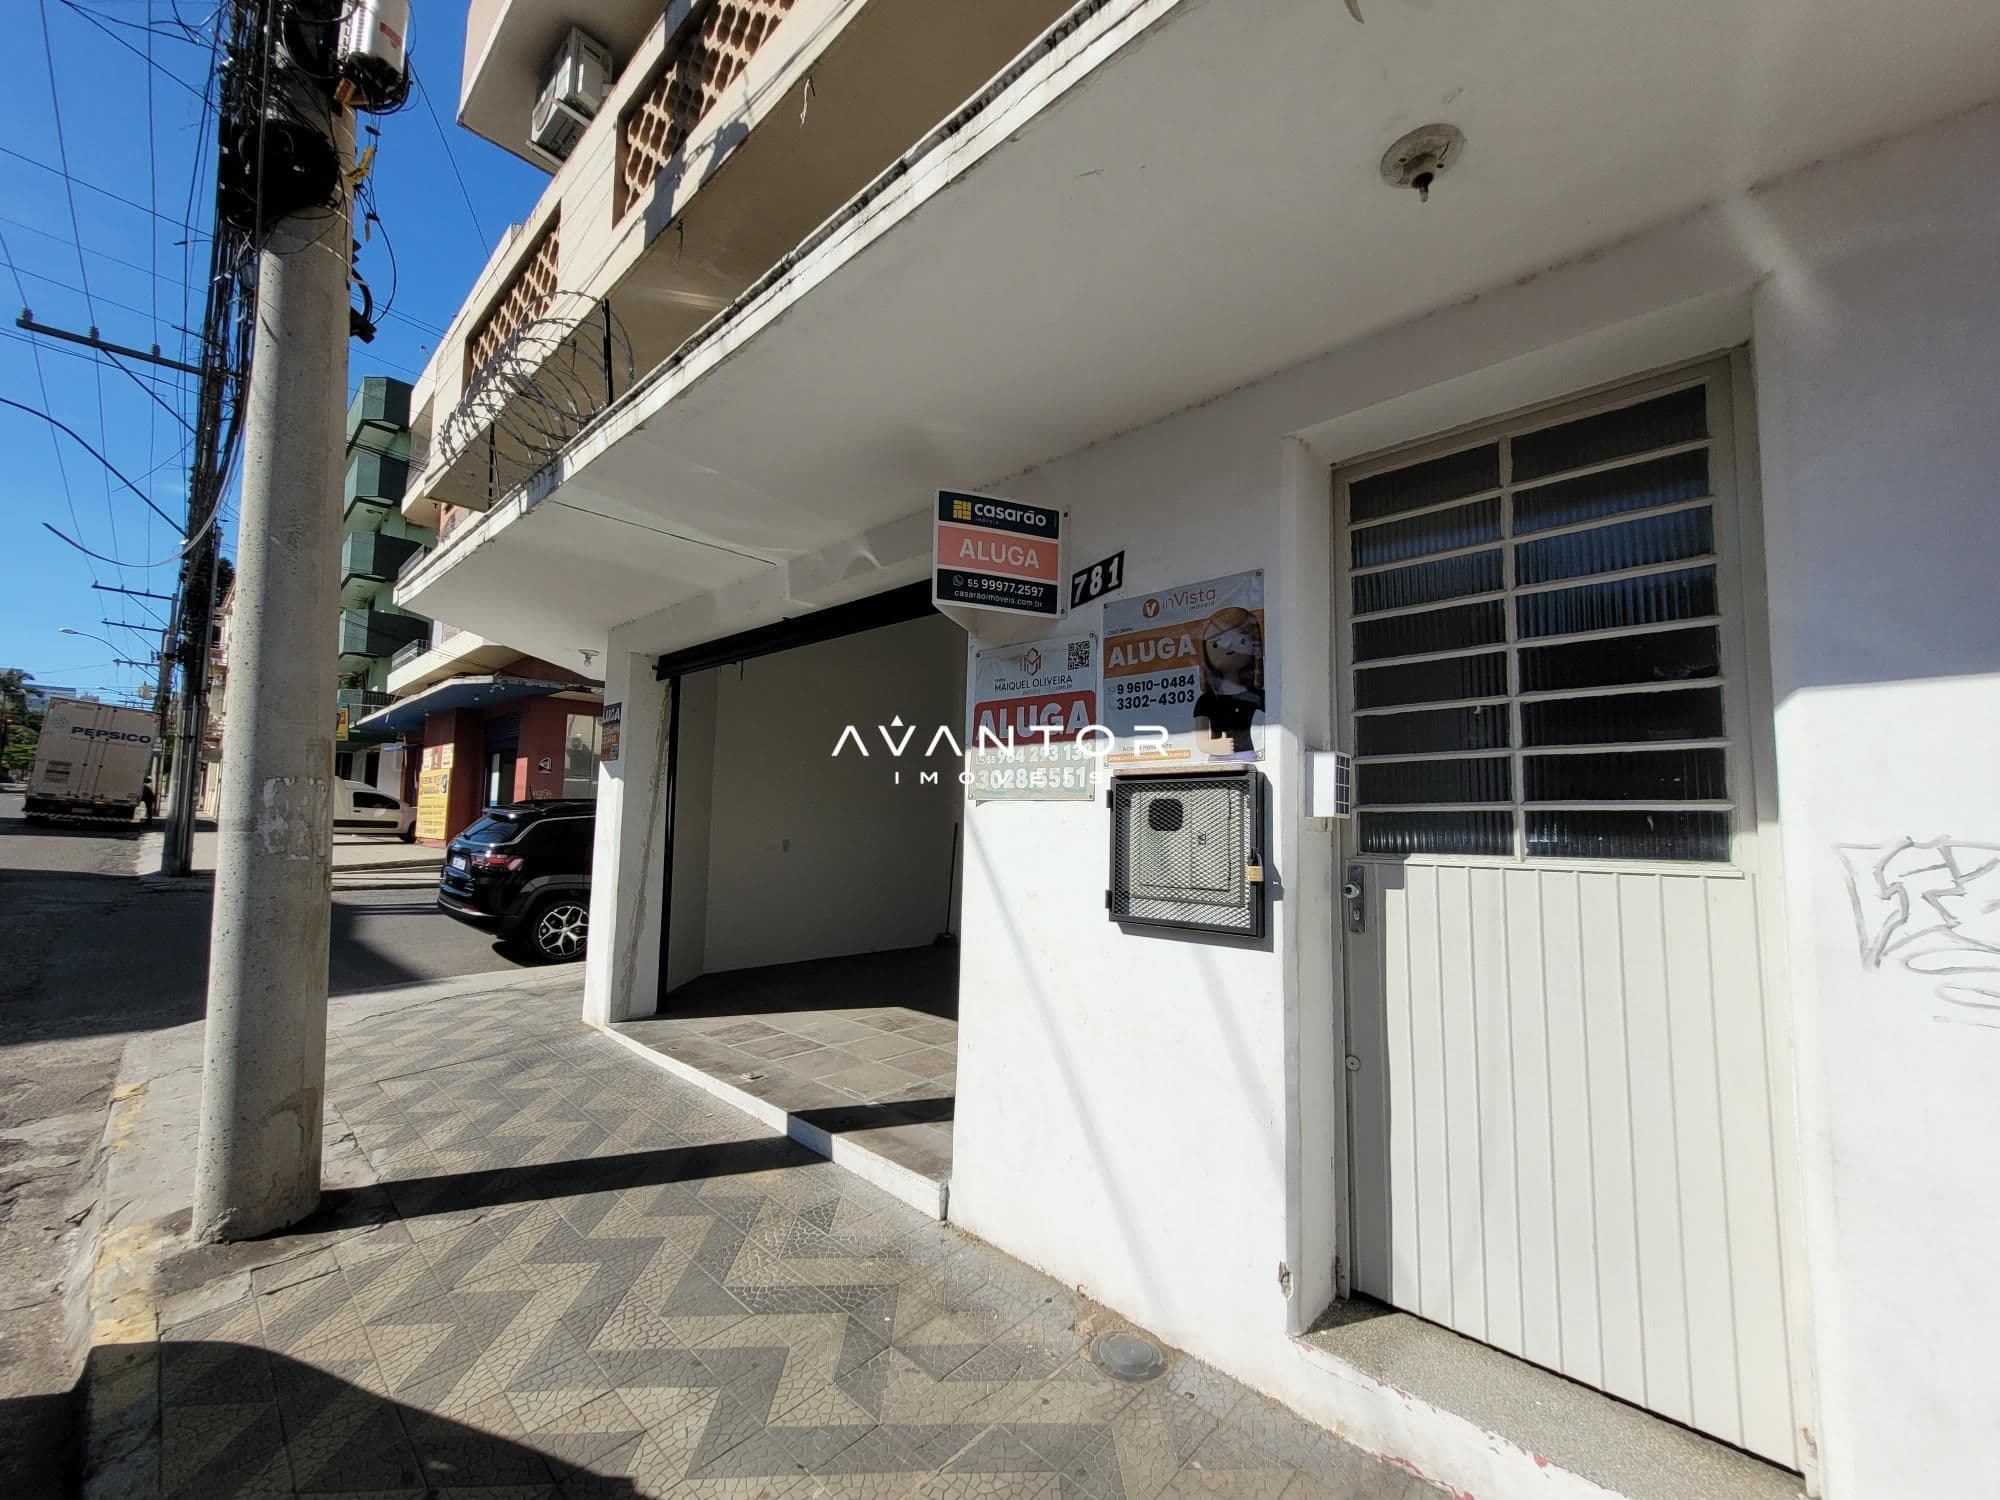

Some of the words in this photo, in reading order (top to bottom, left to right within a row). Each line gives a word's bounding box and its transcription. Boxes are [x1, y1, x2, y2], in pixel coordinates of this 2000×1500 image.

[974, 502, 1047, 527] casarão
[960, 537, 1040, 569] ALUGA
[967, 578, 979, 588] 55
[981, 578, 1044, 598] 99977.2597
[1074, 556, 1119, 604] 781
[1108, 633, 1197, 669] ALUGA
[994, 680, 1031, 693] MAIQUEL
[1032, 675, 1073, 688] OLIVEIRA
[1117, 684, 1124, 695] 9
[1126, 674, 1195, 693] 9610-0484
[1116, 689, 1195, 710] 3302-4303
[976, 700, 1090, 741] ALUGA
[71, 726, 151, 744] PEPSICO
